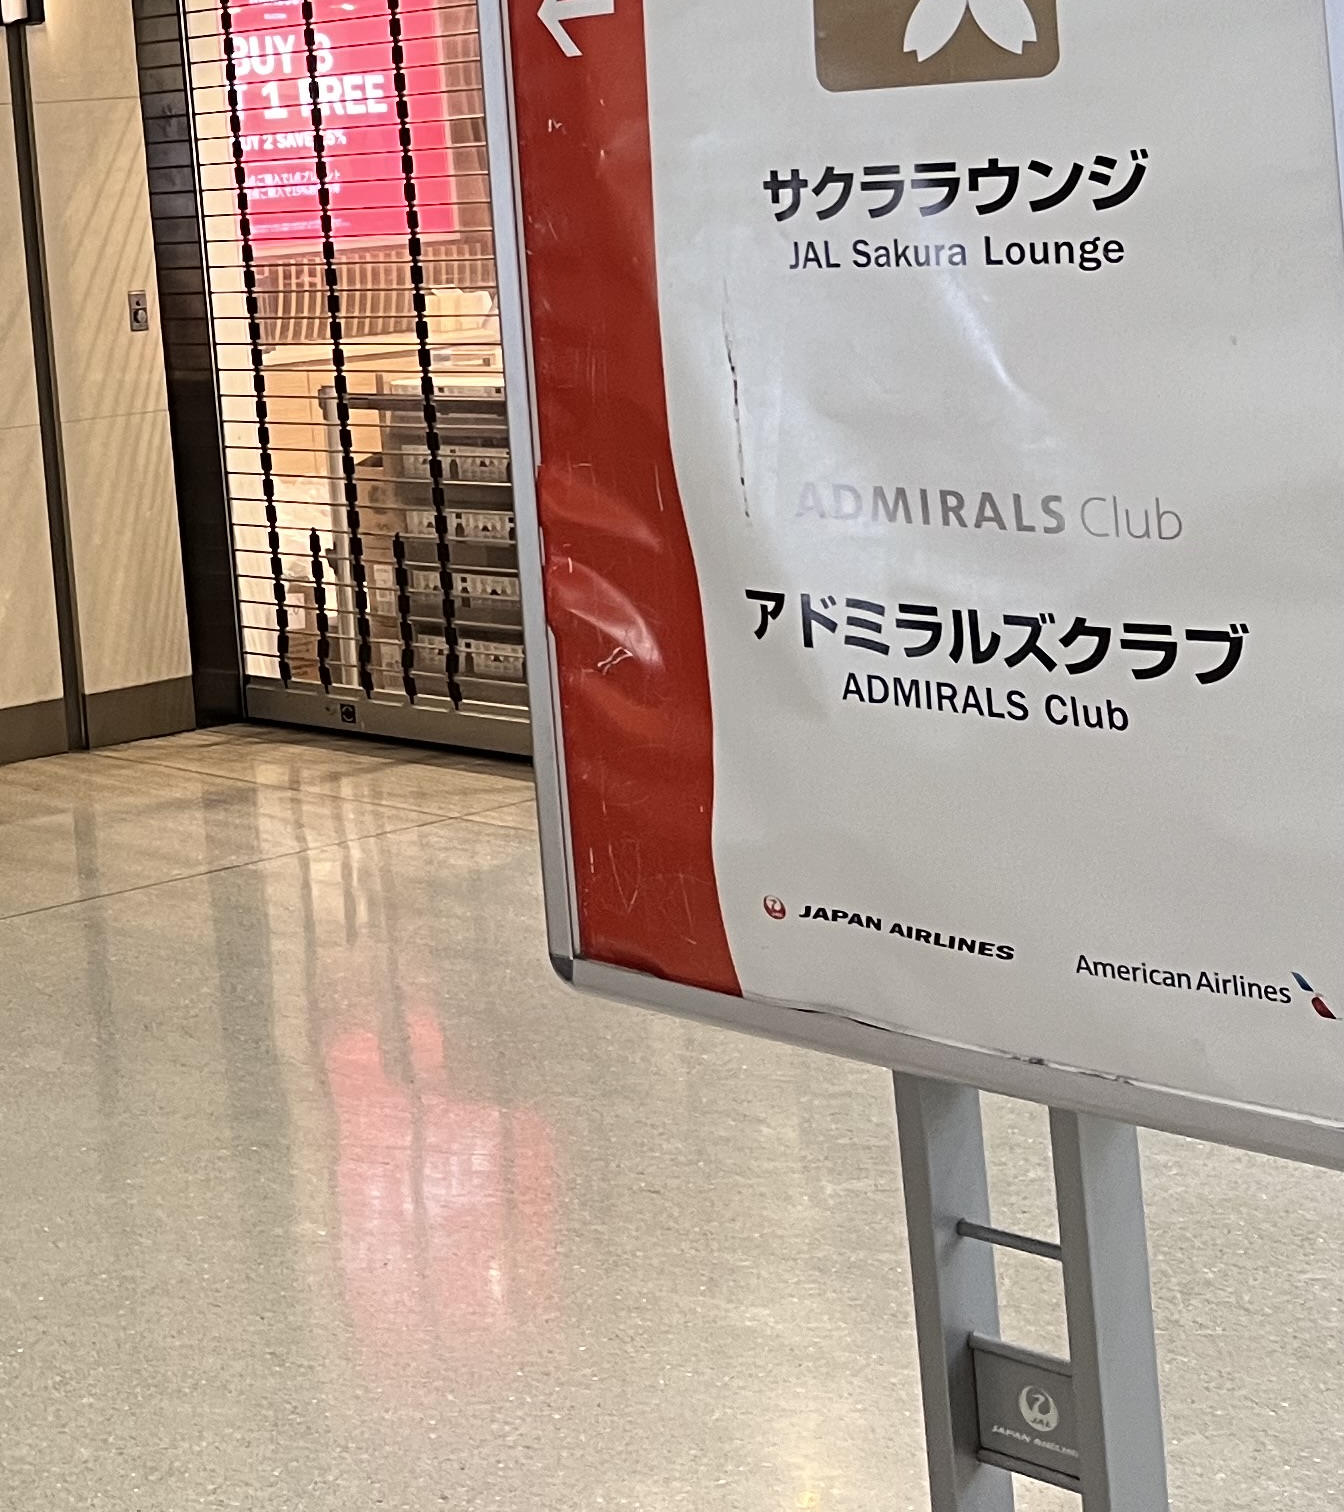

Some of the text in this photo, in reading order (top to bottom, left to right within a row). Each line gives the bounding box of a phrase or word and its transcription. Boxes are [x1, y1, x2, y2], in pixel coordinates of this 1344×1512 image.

[231, 35, 296, 76] BUY
[262, 81, 288, 119] 1
[297, 74, 388, 118] FREE
[239, 133, 260, 152] UY
[263, 134, 275, 150] 2
[277, 131, 315, 149] SAVE
[763, 148, 1149, 223] サクララウンジ
[788, 235, 1125, 272] JAL Sakura Lounge
[794, 482, 1184, 540] ADMIRALS Club
[744, 588, 1251, 685] アドミラルズクラブ
[842, 672, 1129, 731] ADMIRALS Club
[798, 904, 1015, 962] JAPAN AIRLINES
[1076, 954, 1293, 1006] American Airlines
